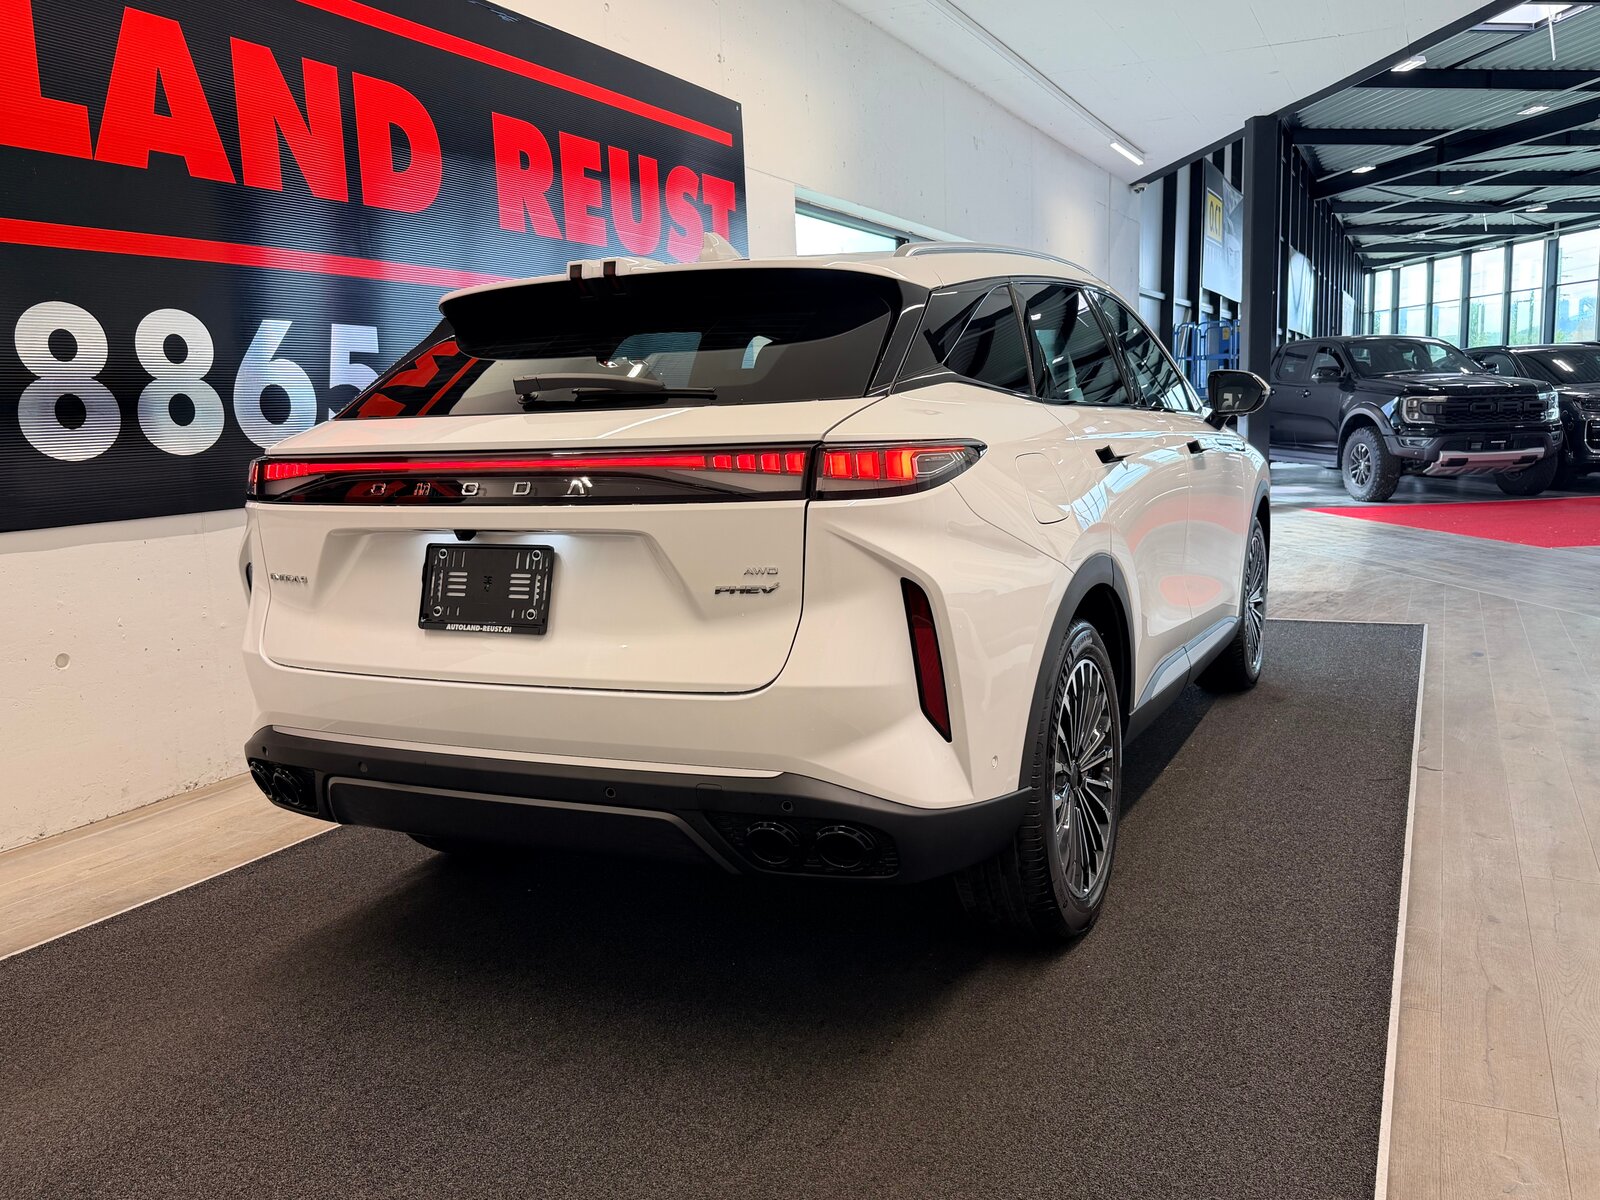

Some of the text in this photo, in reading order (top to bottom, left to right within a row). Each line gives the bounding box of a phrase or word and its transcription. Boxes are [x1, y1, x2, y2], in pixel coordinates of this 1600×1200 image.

[491, 111, 737, 263] REUST
[743, 567, 779, 576] AWD
[714, 582, 780, 595] PHEV
[446, 623, 512, 633] AUTOLAND-REUST.CH
